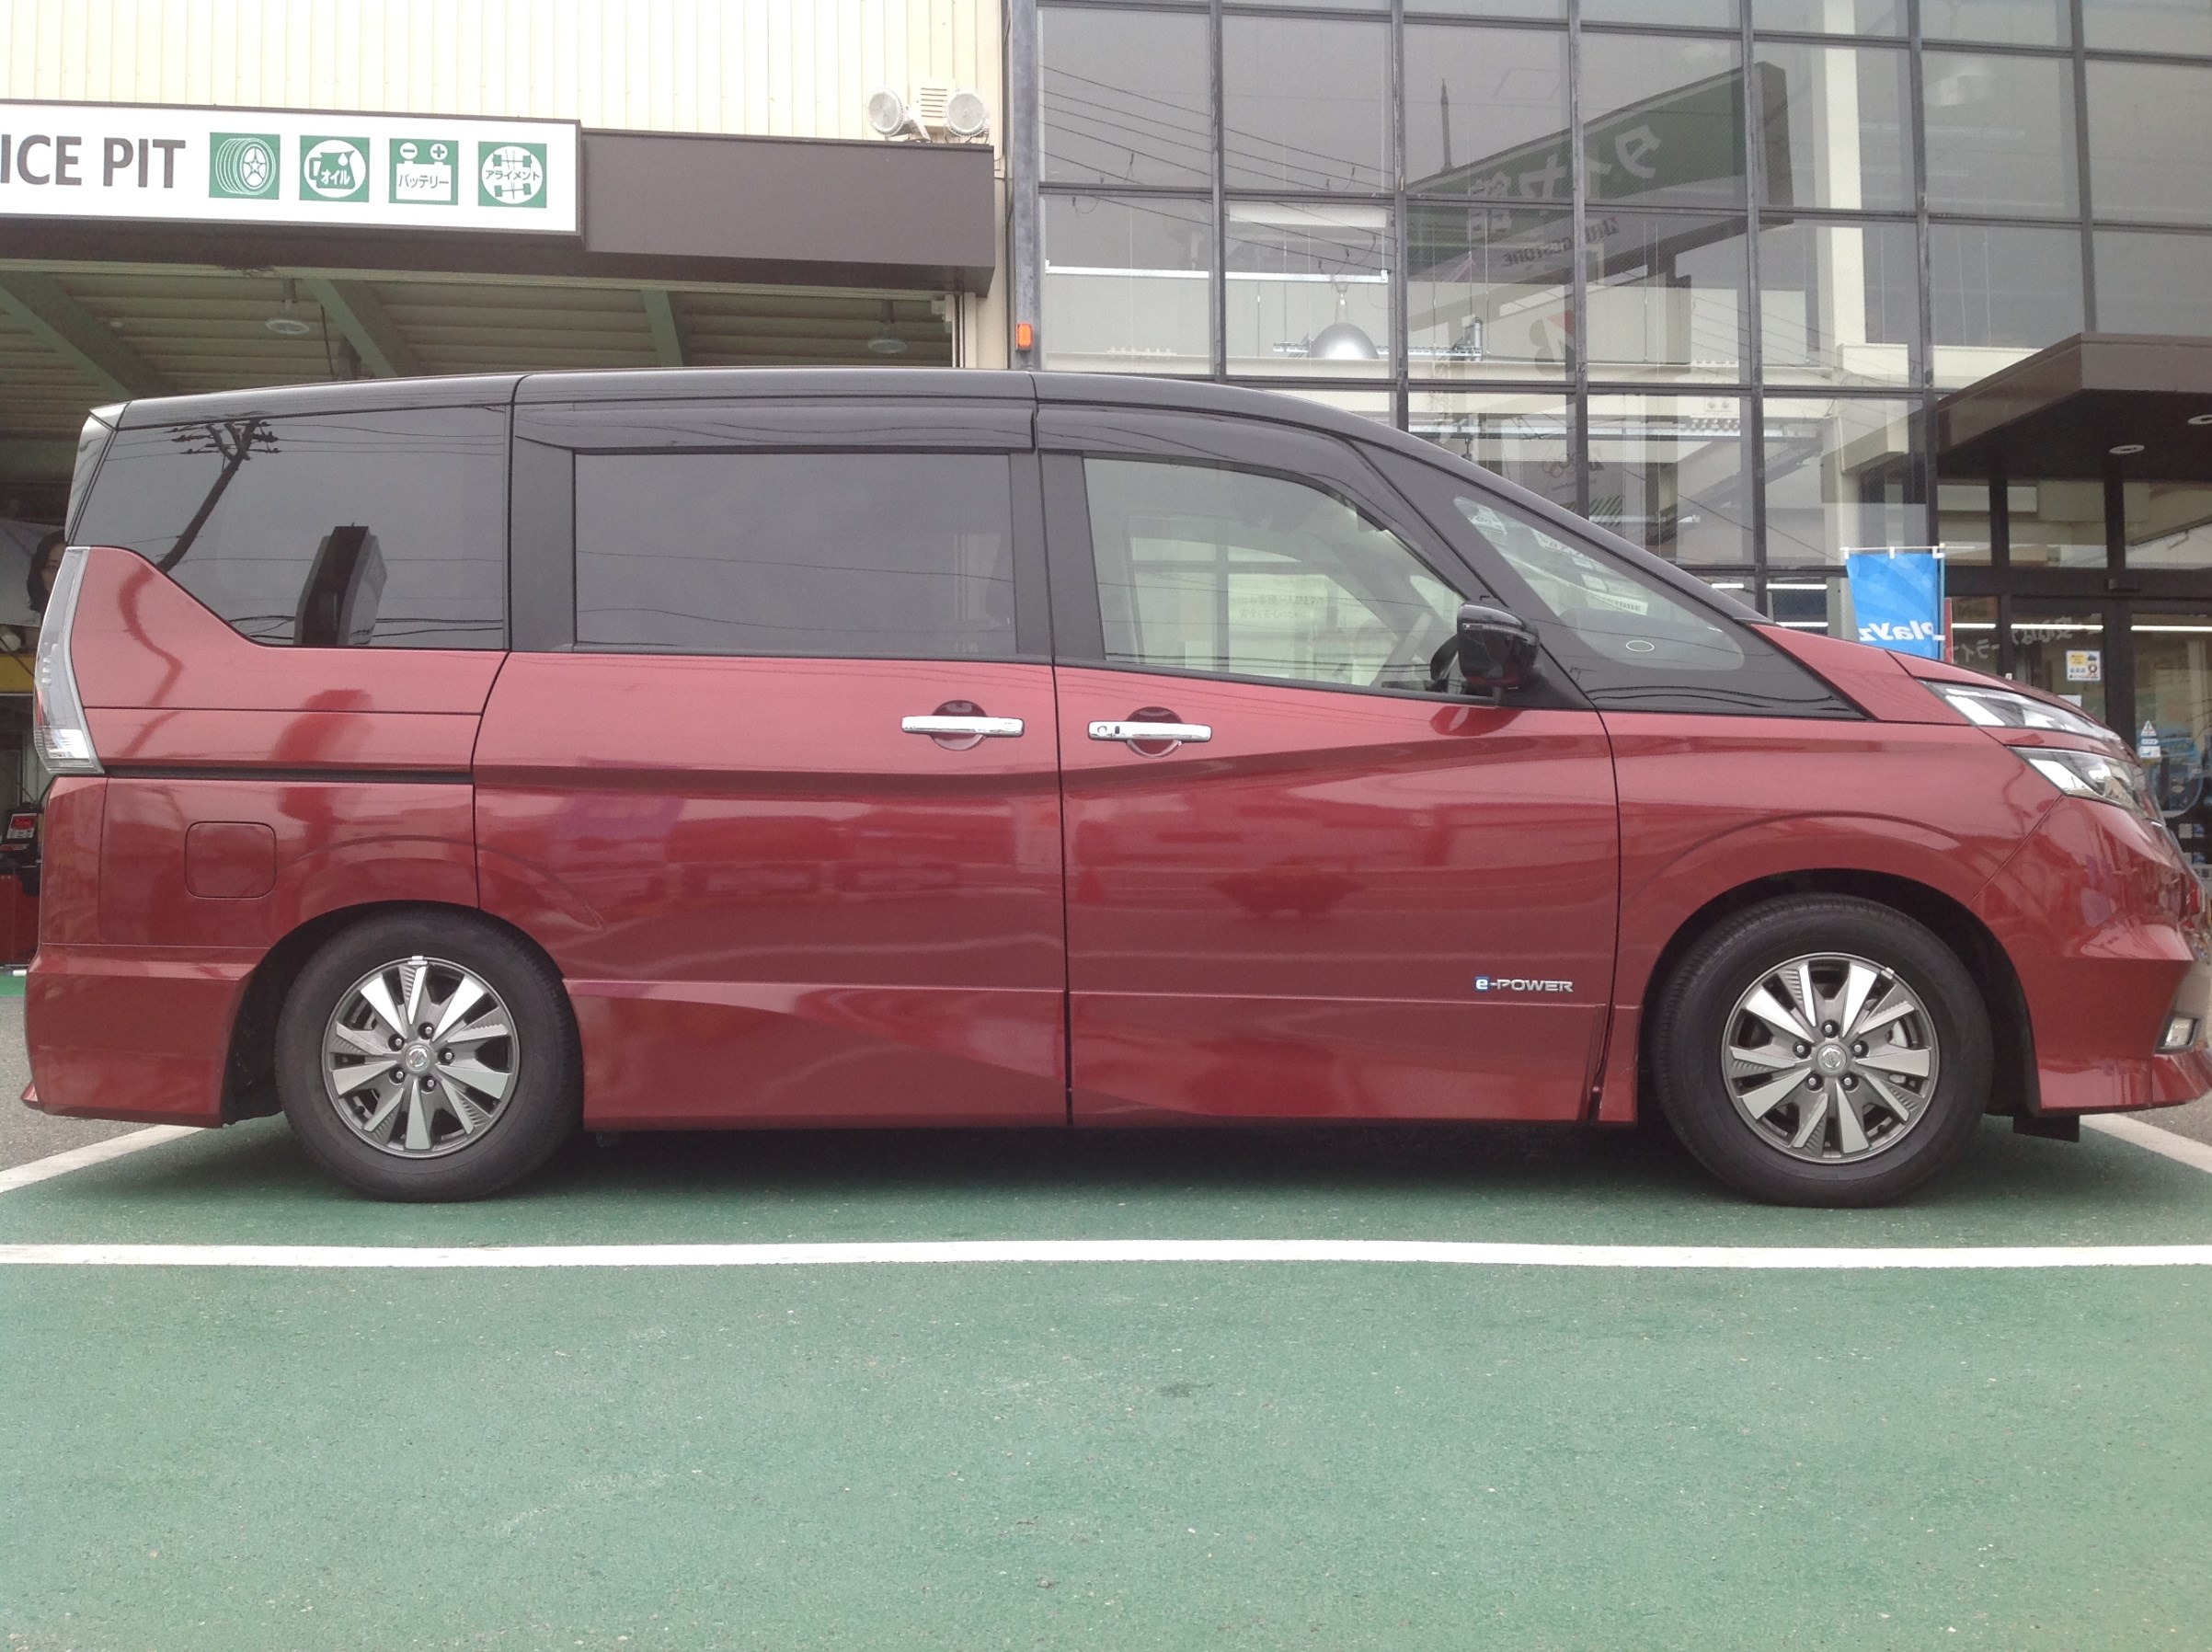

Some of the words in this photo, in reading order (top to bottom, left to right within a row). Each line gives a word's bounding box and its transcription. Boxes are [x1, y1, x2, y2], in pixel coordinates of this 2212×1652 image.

[1, 133, 83, 186] ICE
[103, 137, 186, 189] PIT
[320, 169, 350, 186] オイル
[398, 173, 450, 189] バッテリー
[485, 169, 541, 182] アライメント
[1475, 979, 1574, 992] e-POWER
